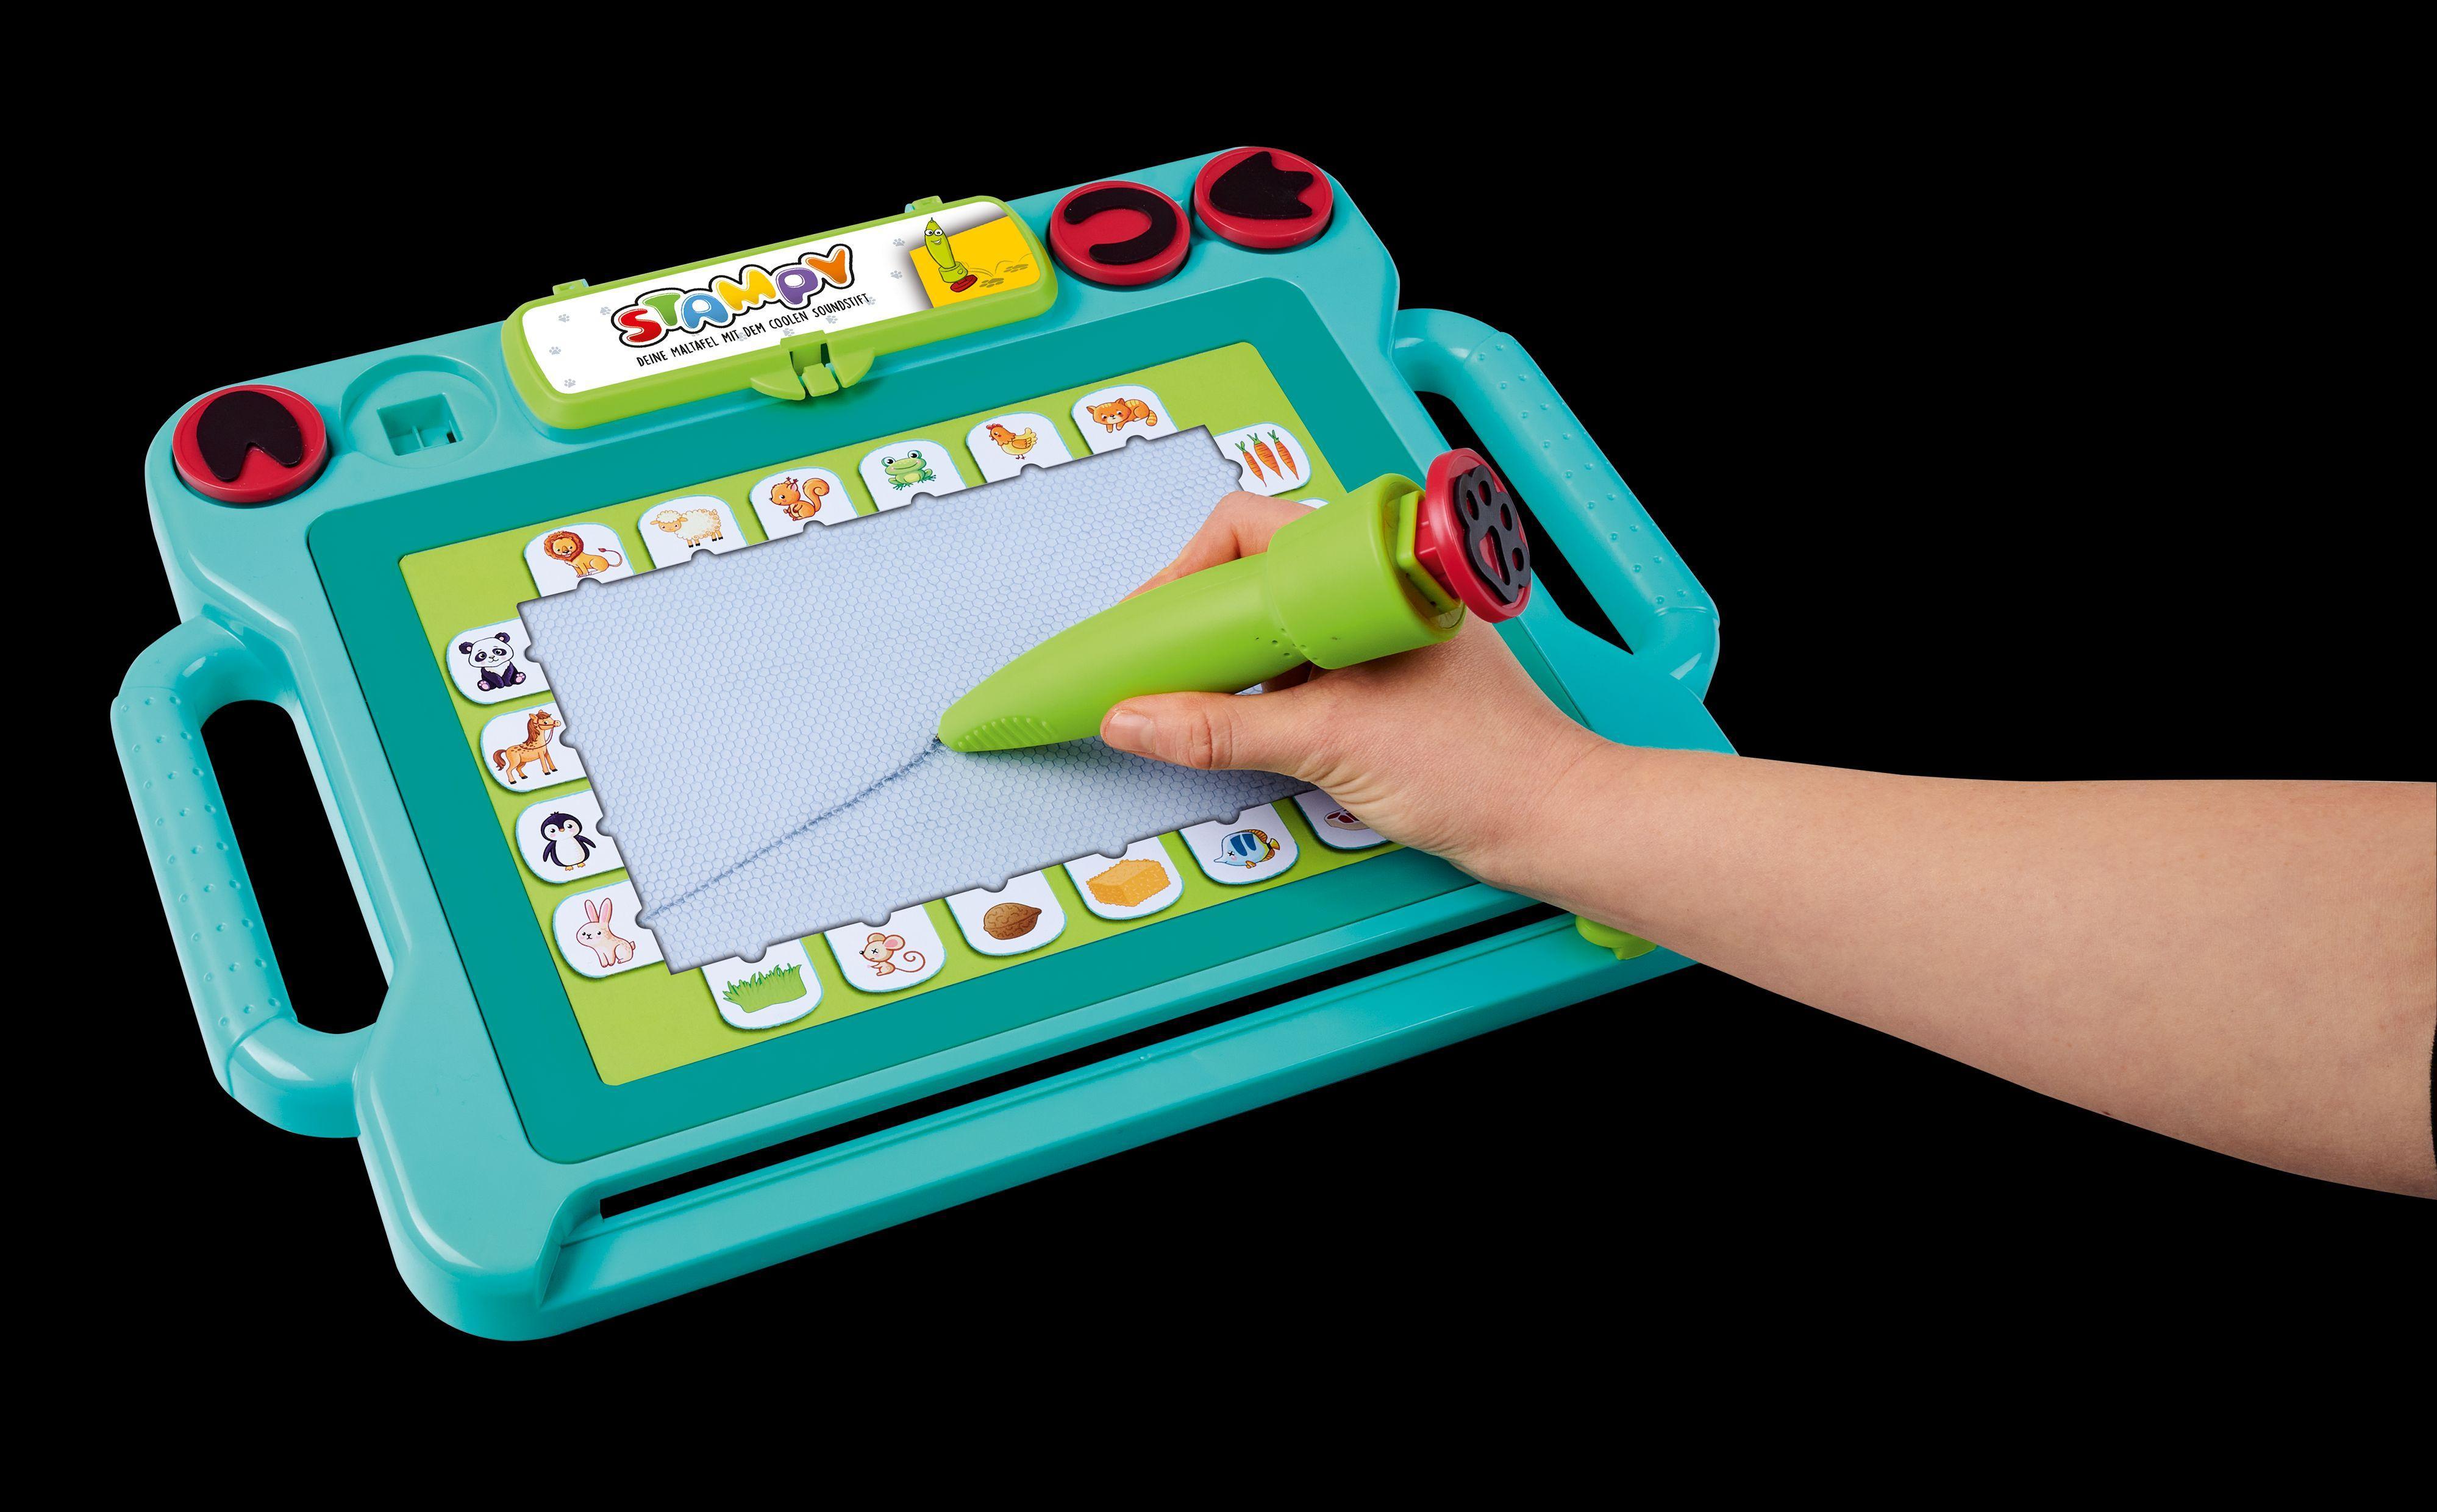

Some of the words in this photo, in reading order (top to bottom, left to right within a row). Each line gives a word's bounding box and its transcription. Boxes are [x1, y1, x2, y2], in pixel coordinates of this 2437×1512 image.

[611, 244, 855, 348] STAMPY
[636, 351, 668, 367] DEINE
[670, 336, 719, 357] MALTAFEL
[721, 329, 740, 343] MIT
[742, 323, 766, 338] DEM
[769, 310, 809, 329] COOLEN
[812, 293, 869, 318] SOUNDSTIFT
